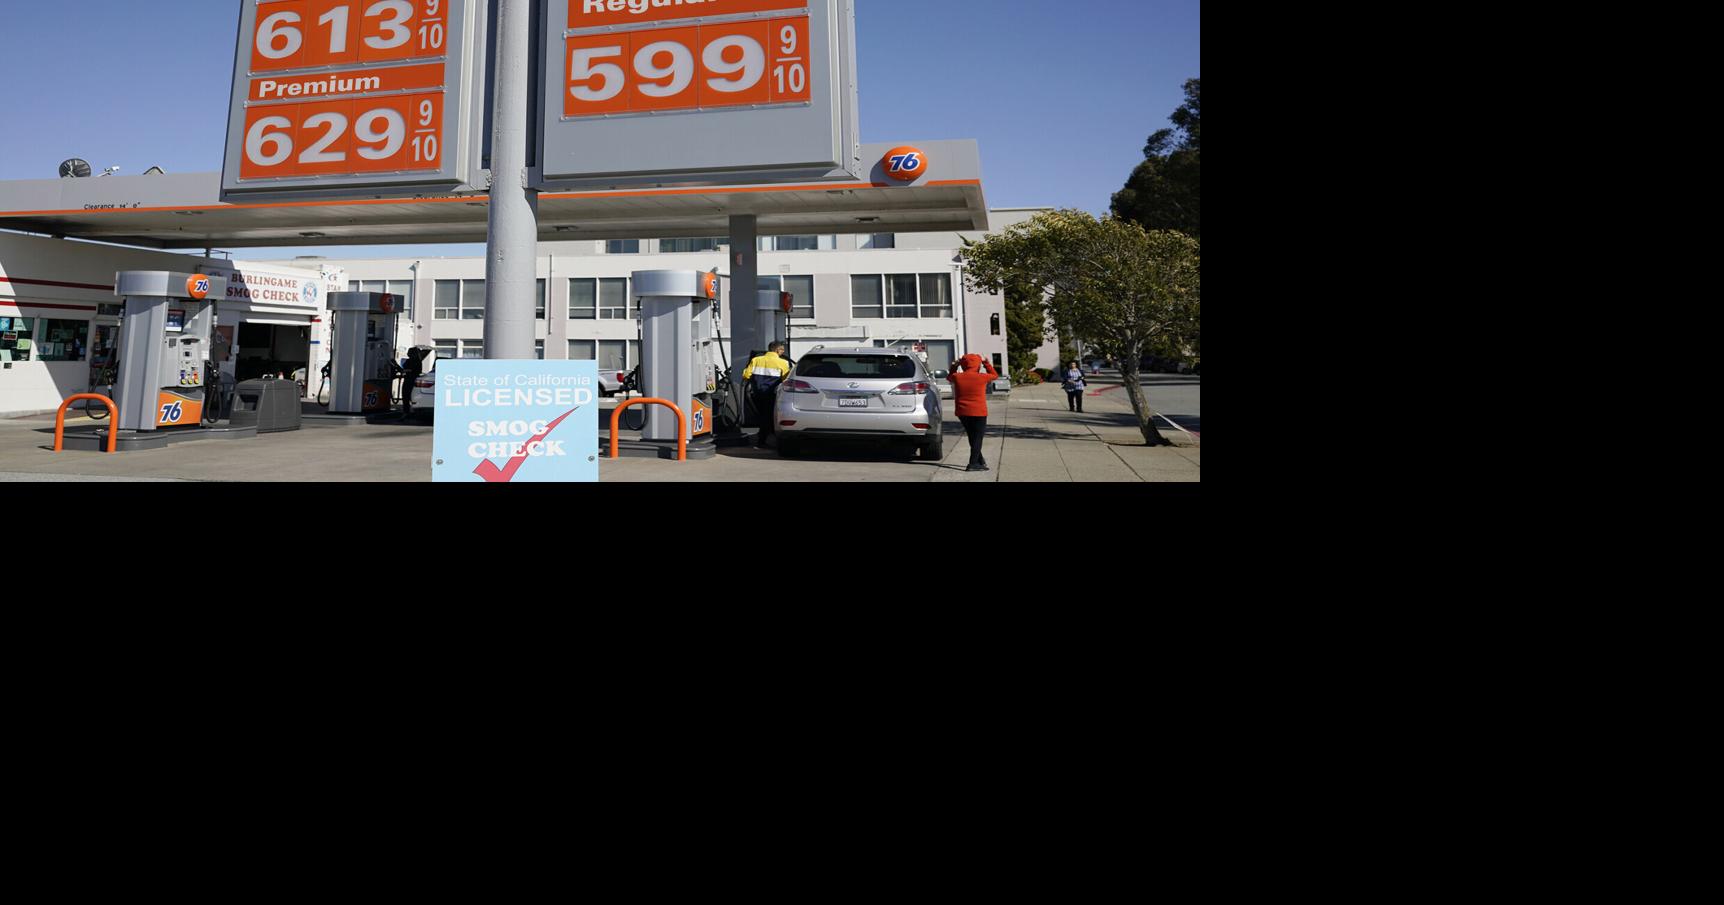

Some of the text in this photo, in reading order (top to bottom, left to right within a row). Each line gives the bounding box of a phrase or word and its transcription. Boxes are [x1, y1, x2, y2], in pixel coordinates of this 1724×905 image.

[582, 0, 717, 14] Regu
[255, 0, 414, 59] 613
[418, 23, 443, 49] 10
[569, 25, 806, 101] 599 9 10
[258, 75, 381, 98] Premium
[245, 99, 438, 166] 629 9 10
[889, 152, 920, 172] 76
[194, 278, 210, 292] 76
[231, 273, 298, 289] BURLINGAME
[226, 286, 260, 299] SMOG
[262, 290, 300, 302] CHECK
[443, 374, 591, 386] State of California
[363, 392, 378, 407] 76
[444, 387, 593, 407] LICENSED
[160, 400, 183, 423] 76
[693, 409, 704, 433] 76
[467, 420, 550, 437] SMOG
[467, 440, 567, 459] CHECK
